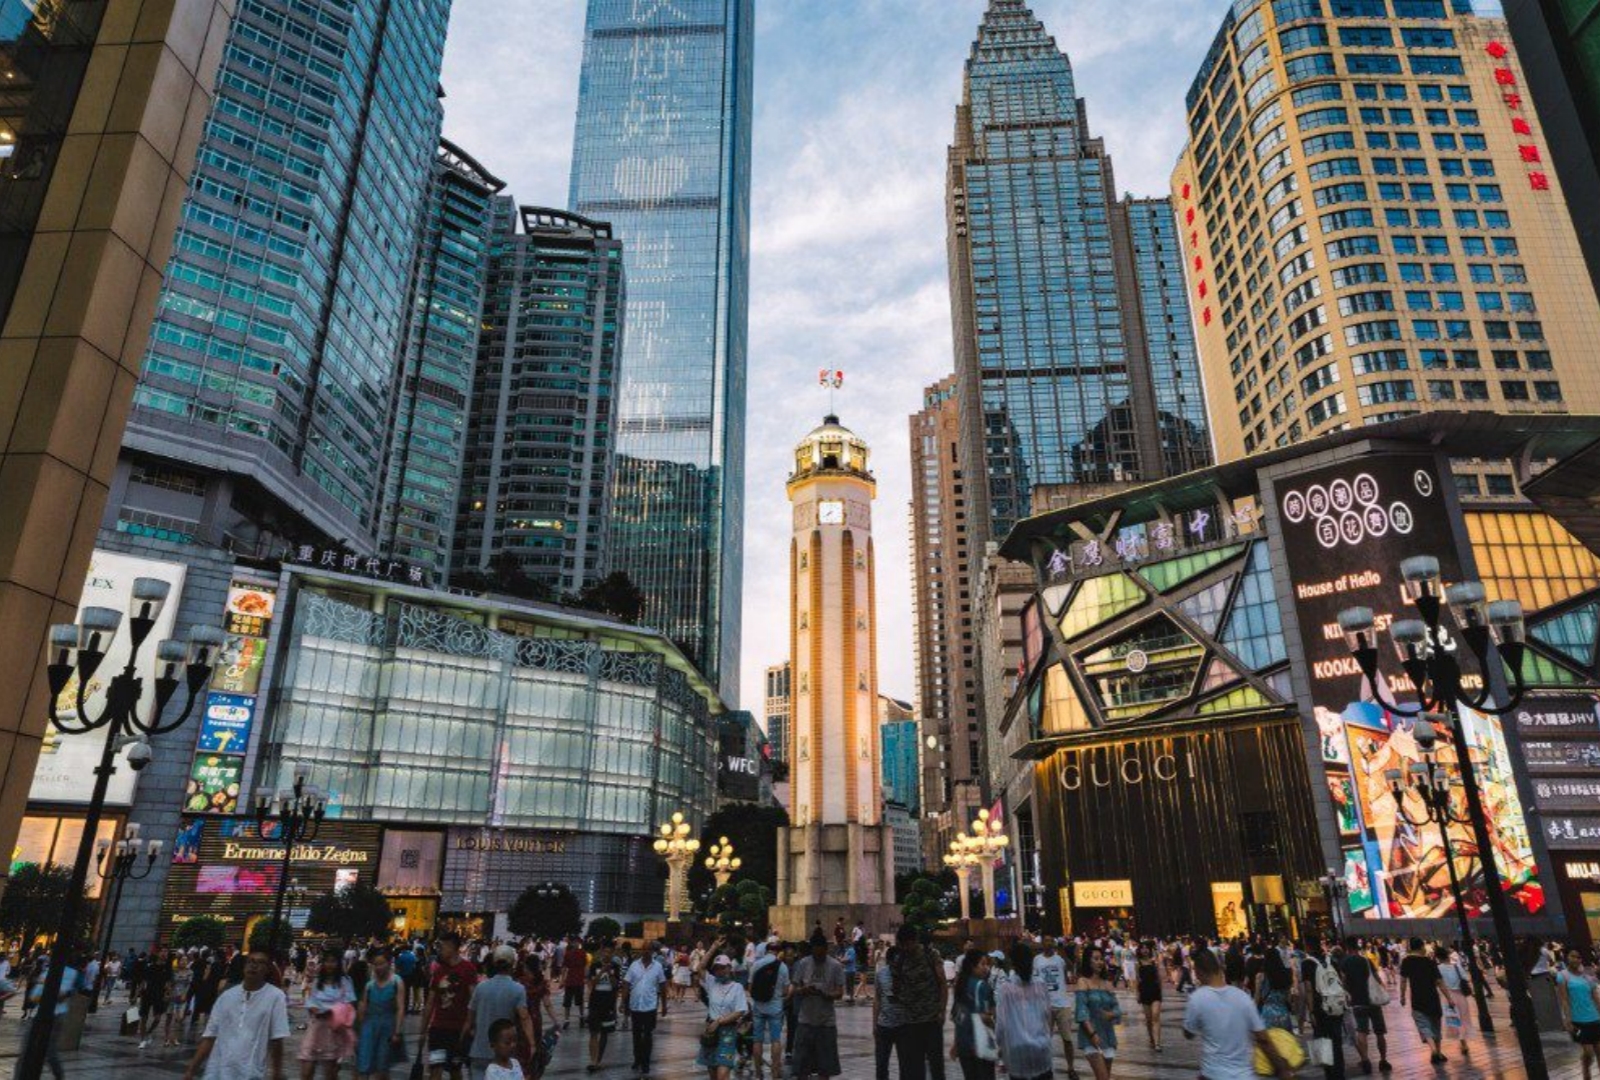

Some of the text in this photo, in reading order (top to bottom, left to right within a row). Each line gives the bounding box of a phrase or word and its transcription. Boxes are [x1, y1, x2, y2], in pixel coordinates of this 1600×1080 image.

[297, 544, 424, 582] 重庆时代广场
[1298, 570, 1381, 599] House of Hello
[728, 755, 756, 775] WFC
[1061, 752, 1195, 790] GUCCI
[322, 845, 367, 864] Zegna
[1082, 890, 1124, 899] GUCCI
